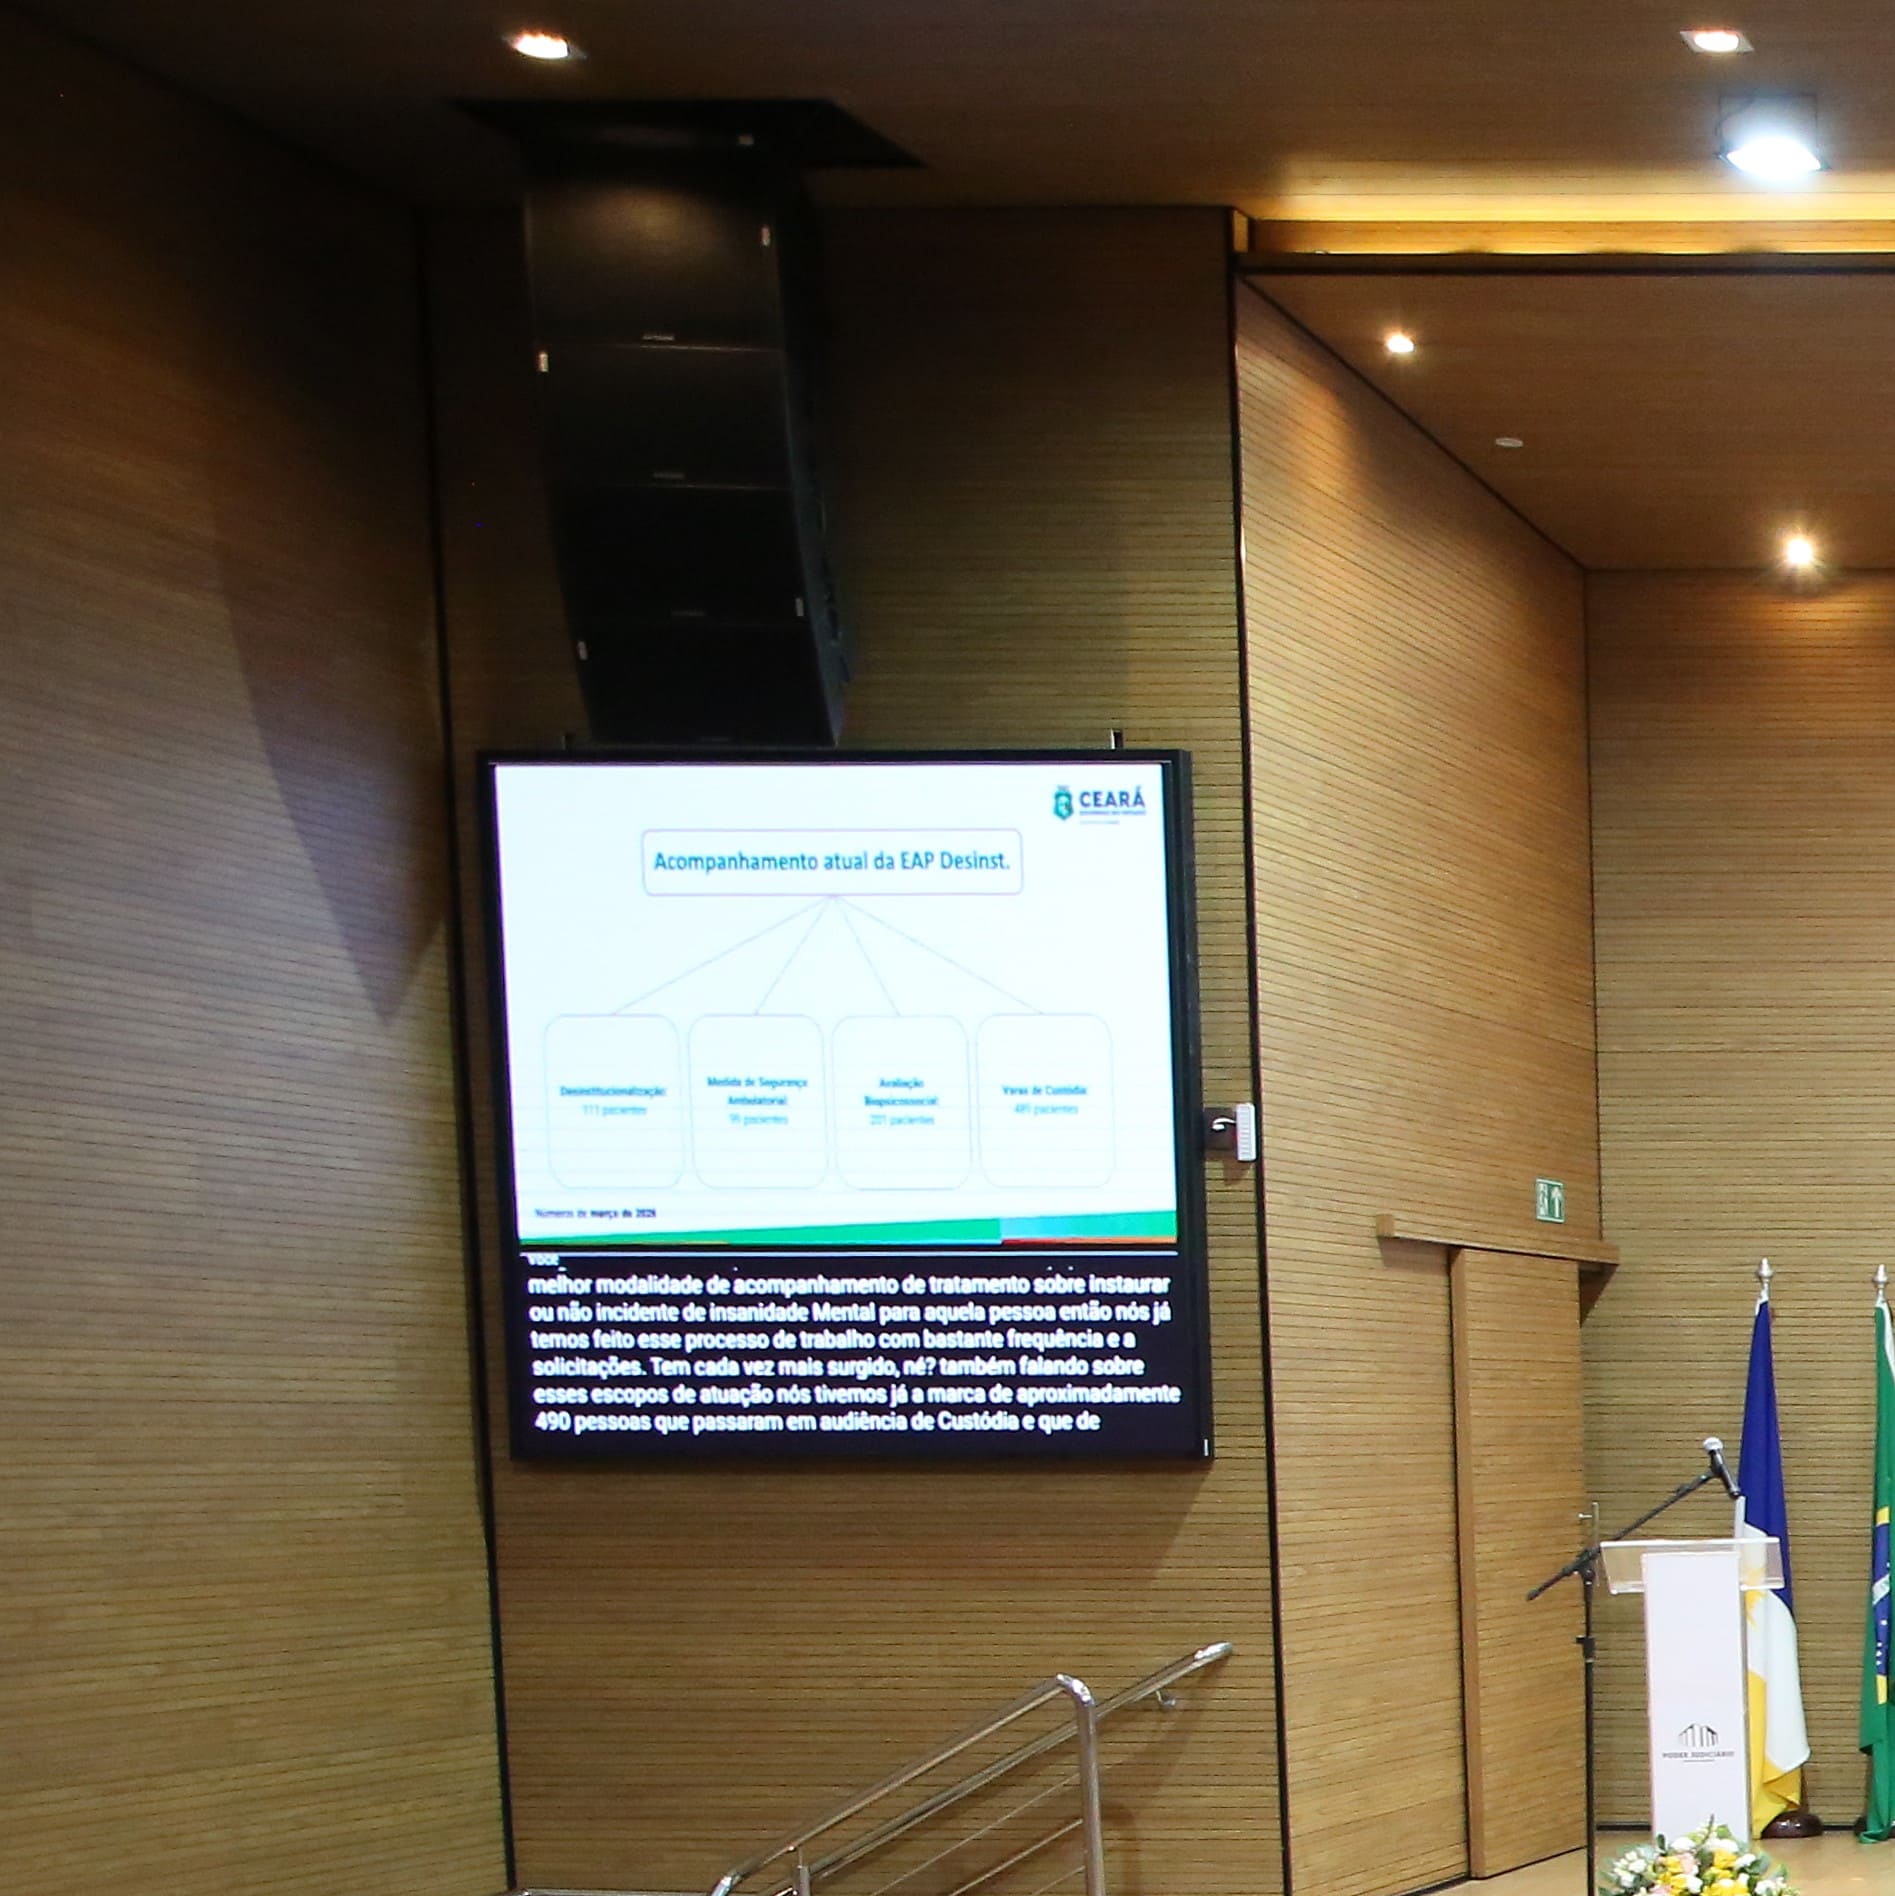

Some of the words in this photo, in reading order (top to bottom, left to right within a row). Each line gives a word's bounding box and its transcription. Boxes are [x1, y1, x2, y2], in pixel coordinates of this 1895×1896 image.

[1078, 785, 1145, 809] CEARÁ
[653, 850, 818, 874] Acompanhamento
[823, 850, 868, 871] atual
[872, 850, 895, 871] da
[899, 850, 935, 870] EAP
[939, 850, 1010, 870] Desinst.
[527, 1274, 593, 1295] melhor
[595, 1273, 704, 1295] modalidade
[705, 1274, 731, 1294] de
[733, 1274, 900, 1298] acompanhamento
[901, 1274, 926, 1295] de
[928, 1274, 1031, 1295] tratamento
[1033, 1273, 1086, 1294] sobre
[1088, 1273, 1171, 1294] instaurar
[528, 1306, 554, 1322] ou
[556, 1300, 593, 1322] não
[595, 1302, 680, 1323] incidente
[682, 1301, 707, 1323] de
[709, 1301, 809, 1322] insanidade
[811, 1301, 876, 1322] Mental
[878, 1305, 921, 1325] para
[923, 1301, 986, 1325] aquela
[988, 1304, 1057, 1325] pessoa
[1058, 1299, 1113, 1321] então
[1114, 1300, 1151, 1321] nós
[1152, 1300, 1171, 1324] já
[530, 1330, 590, 1349] temos
[592, 1328, 635, 1349] feito
[636, 1333, 682, 1350] esse
[684, 1332, 770, 1353] processo
[772, 1328, 797, 1349] de
[799, 1328, 876, 1349] trabalho
[878, 1332, 921, 1349] com
[922, 1328, 1005, 1349] bastante
[1006, 1327, 1104, 1352] frequência
[1106, 1331, 1120, 1348] e
[1122, 1331, 1136, 1348] a
[532, 1355, 647, 1380] solicitações.
[649, 1355, 691, 1377] Tem
[693, 1355, 740, 1376] cada
[742, 1359, 775, 1376] vez
[777, 1356, 824, 1376] mais
[826, 1355, 901, 1379] surgido,
[902, 1356, 937, 1376] né?
[938, 1355, 1016, 1376] também
[1018, 1354, 1089, 1376] falando
[1091, 1354, 1145, 1375] sobre
[533, 1387, 589, 1404] esses
[590, 1387, 669, 1408] escopos
[671, 1383, 697, 1405] de
[699, 1382, 774, 1407] atuação
[776, 1383, 812, 1404] nós
[813, 1383, 888, 1404] tivemos
[889, 1383, 908, 1407] já
[911, 1387, 924, 1404] a
[927, 1387, 986, 1404] marca
[988, 1383, 1014, 1404] de
[1016, 1382, 1181, 1407] aproximadamente
[535, 1410, 572, 1431] 490
[574, 1415, 652, 1436] pessoas
[654, 1415, 690, 1436] que
[692, 1414, 784, 1435] passaram
[785, 1414, 817, 1431] em
[819, 1410, 908, 1431] audiência
[910, 1410, 935, 1431] de
[937, 1410, 1020, 1431] Custódia
[1021, 1414, 1036, 1431] e
[1037, 1413, 1074, 1434] que
[1075, 1409, 1101, 1430] de
